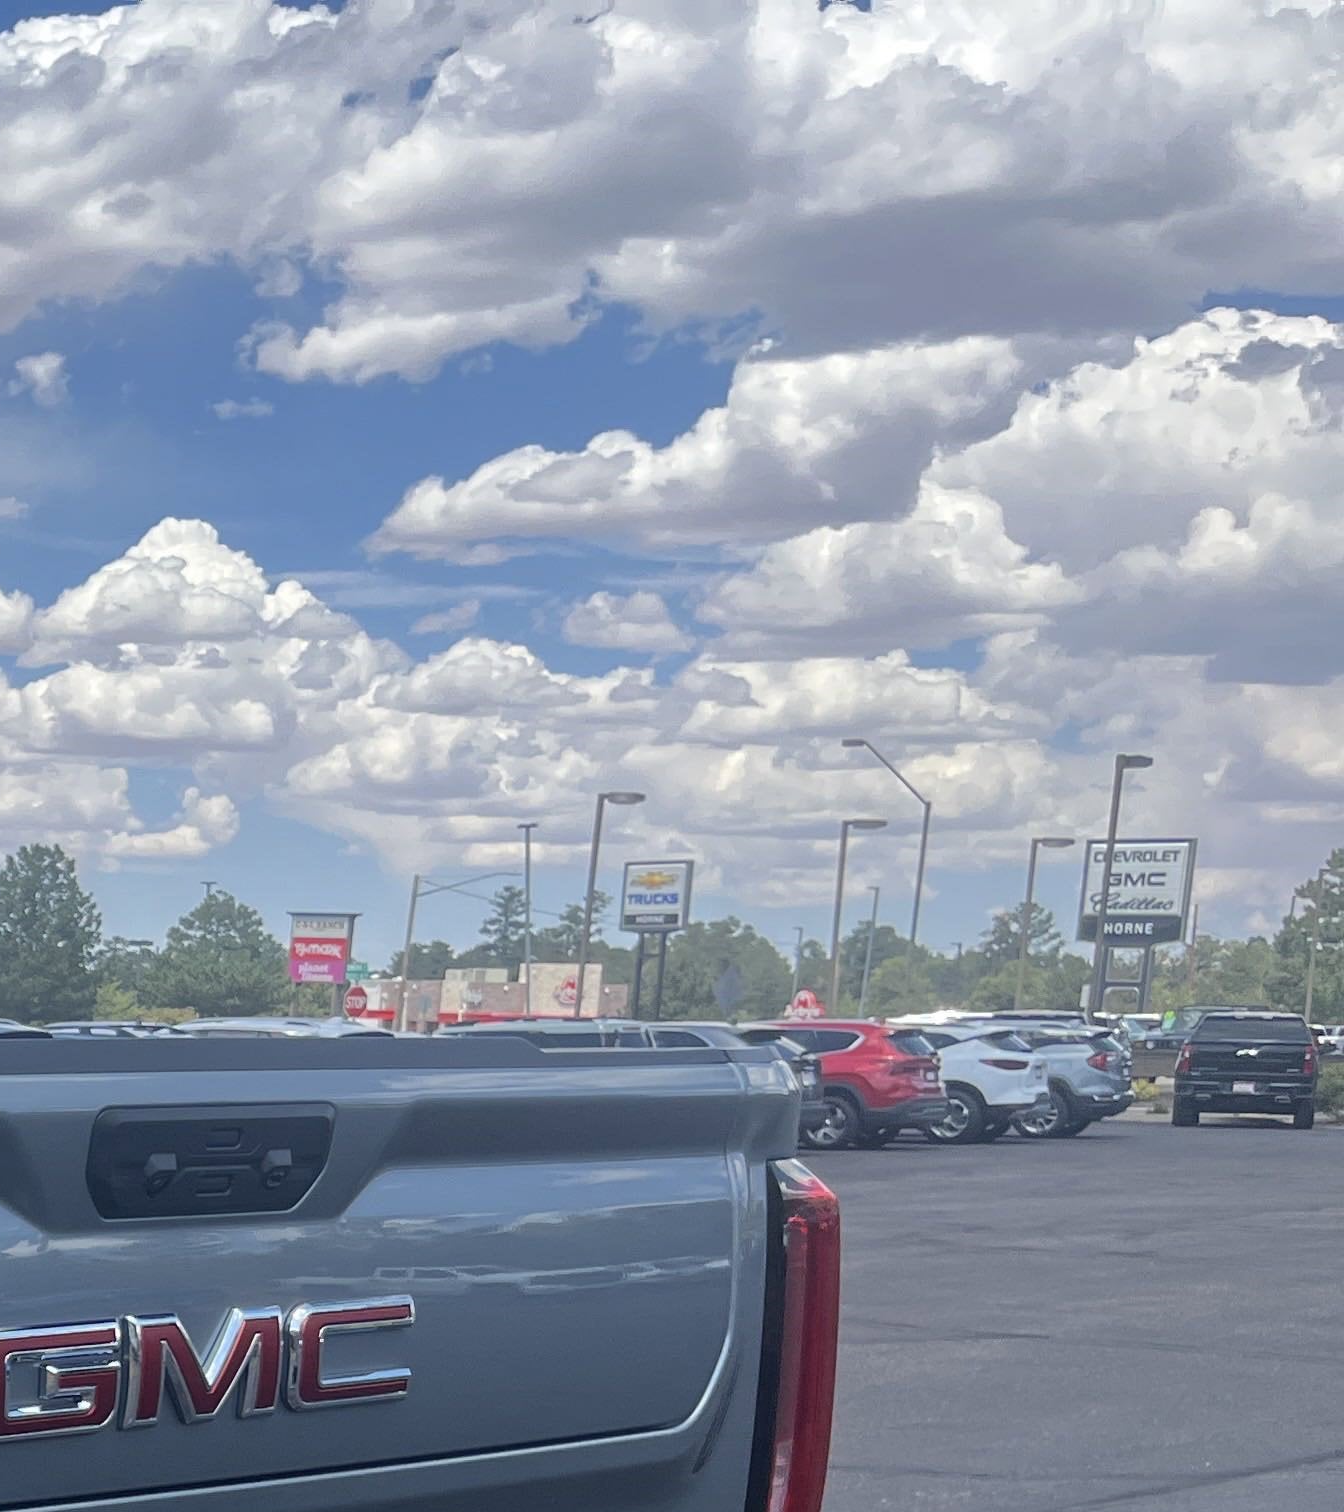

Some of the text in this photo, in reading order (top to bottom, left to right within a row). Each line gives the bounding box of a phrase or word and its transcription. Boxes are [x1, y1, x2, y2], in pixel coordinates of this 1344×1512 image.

[1094, 849, 1181, 863] CEVROLET
[627, 893, 679, 905] TRUCKS
[1103, 922, 1154, 935] HORNE
[345, 995, 367, 1009] STOP
